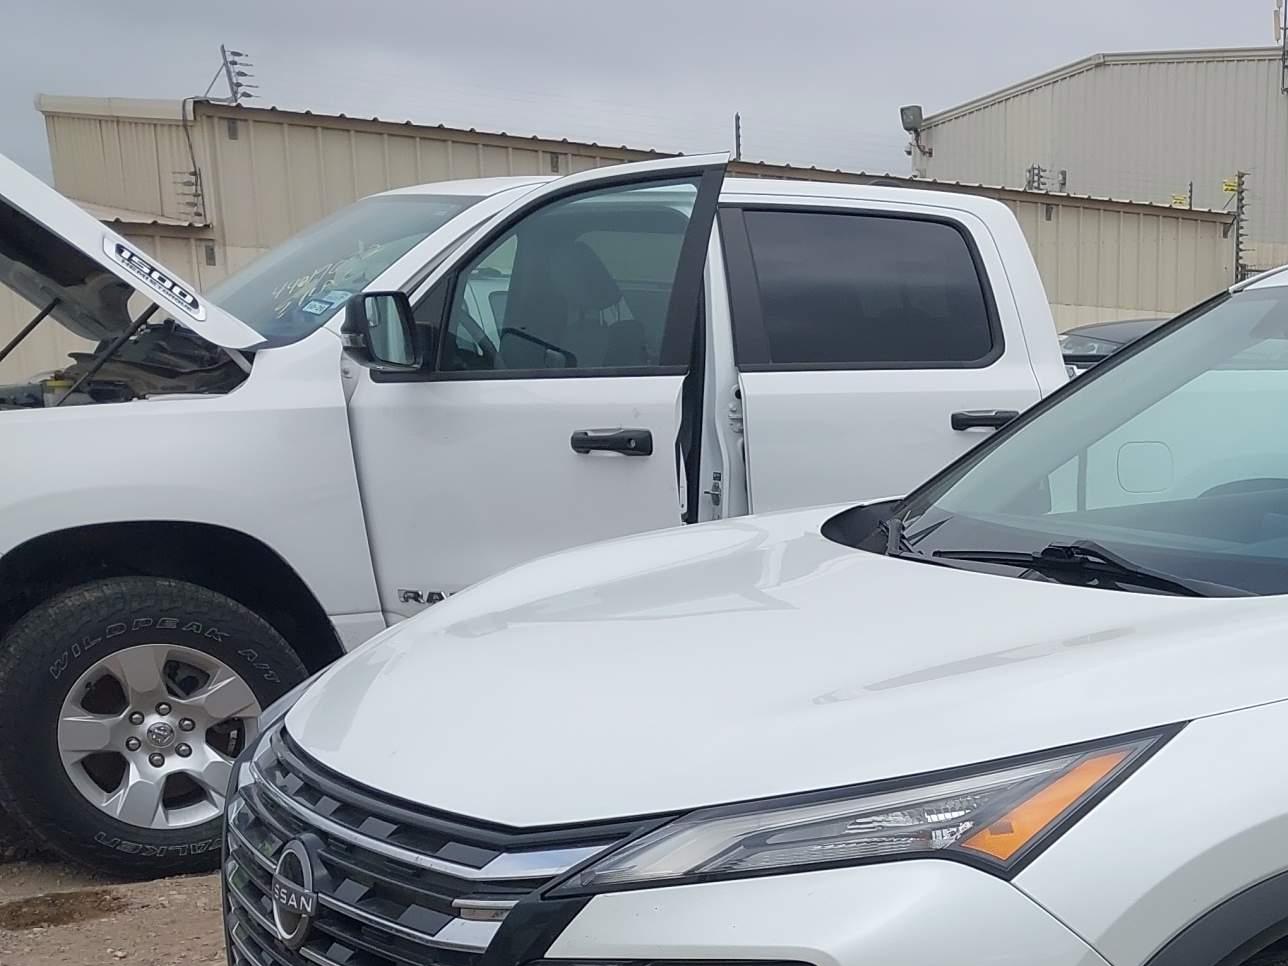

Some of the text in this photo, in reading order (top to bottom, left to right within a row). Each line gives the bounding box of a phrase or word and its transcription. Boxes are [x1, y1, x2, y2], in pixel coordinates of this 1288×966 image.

[118, 246, 194, 304] 1500
[397, 588, 457, 604] RA
[50, 617, 281, 683] WILDPEAK A/T
